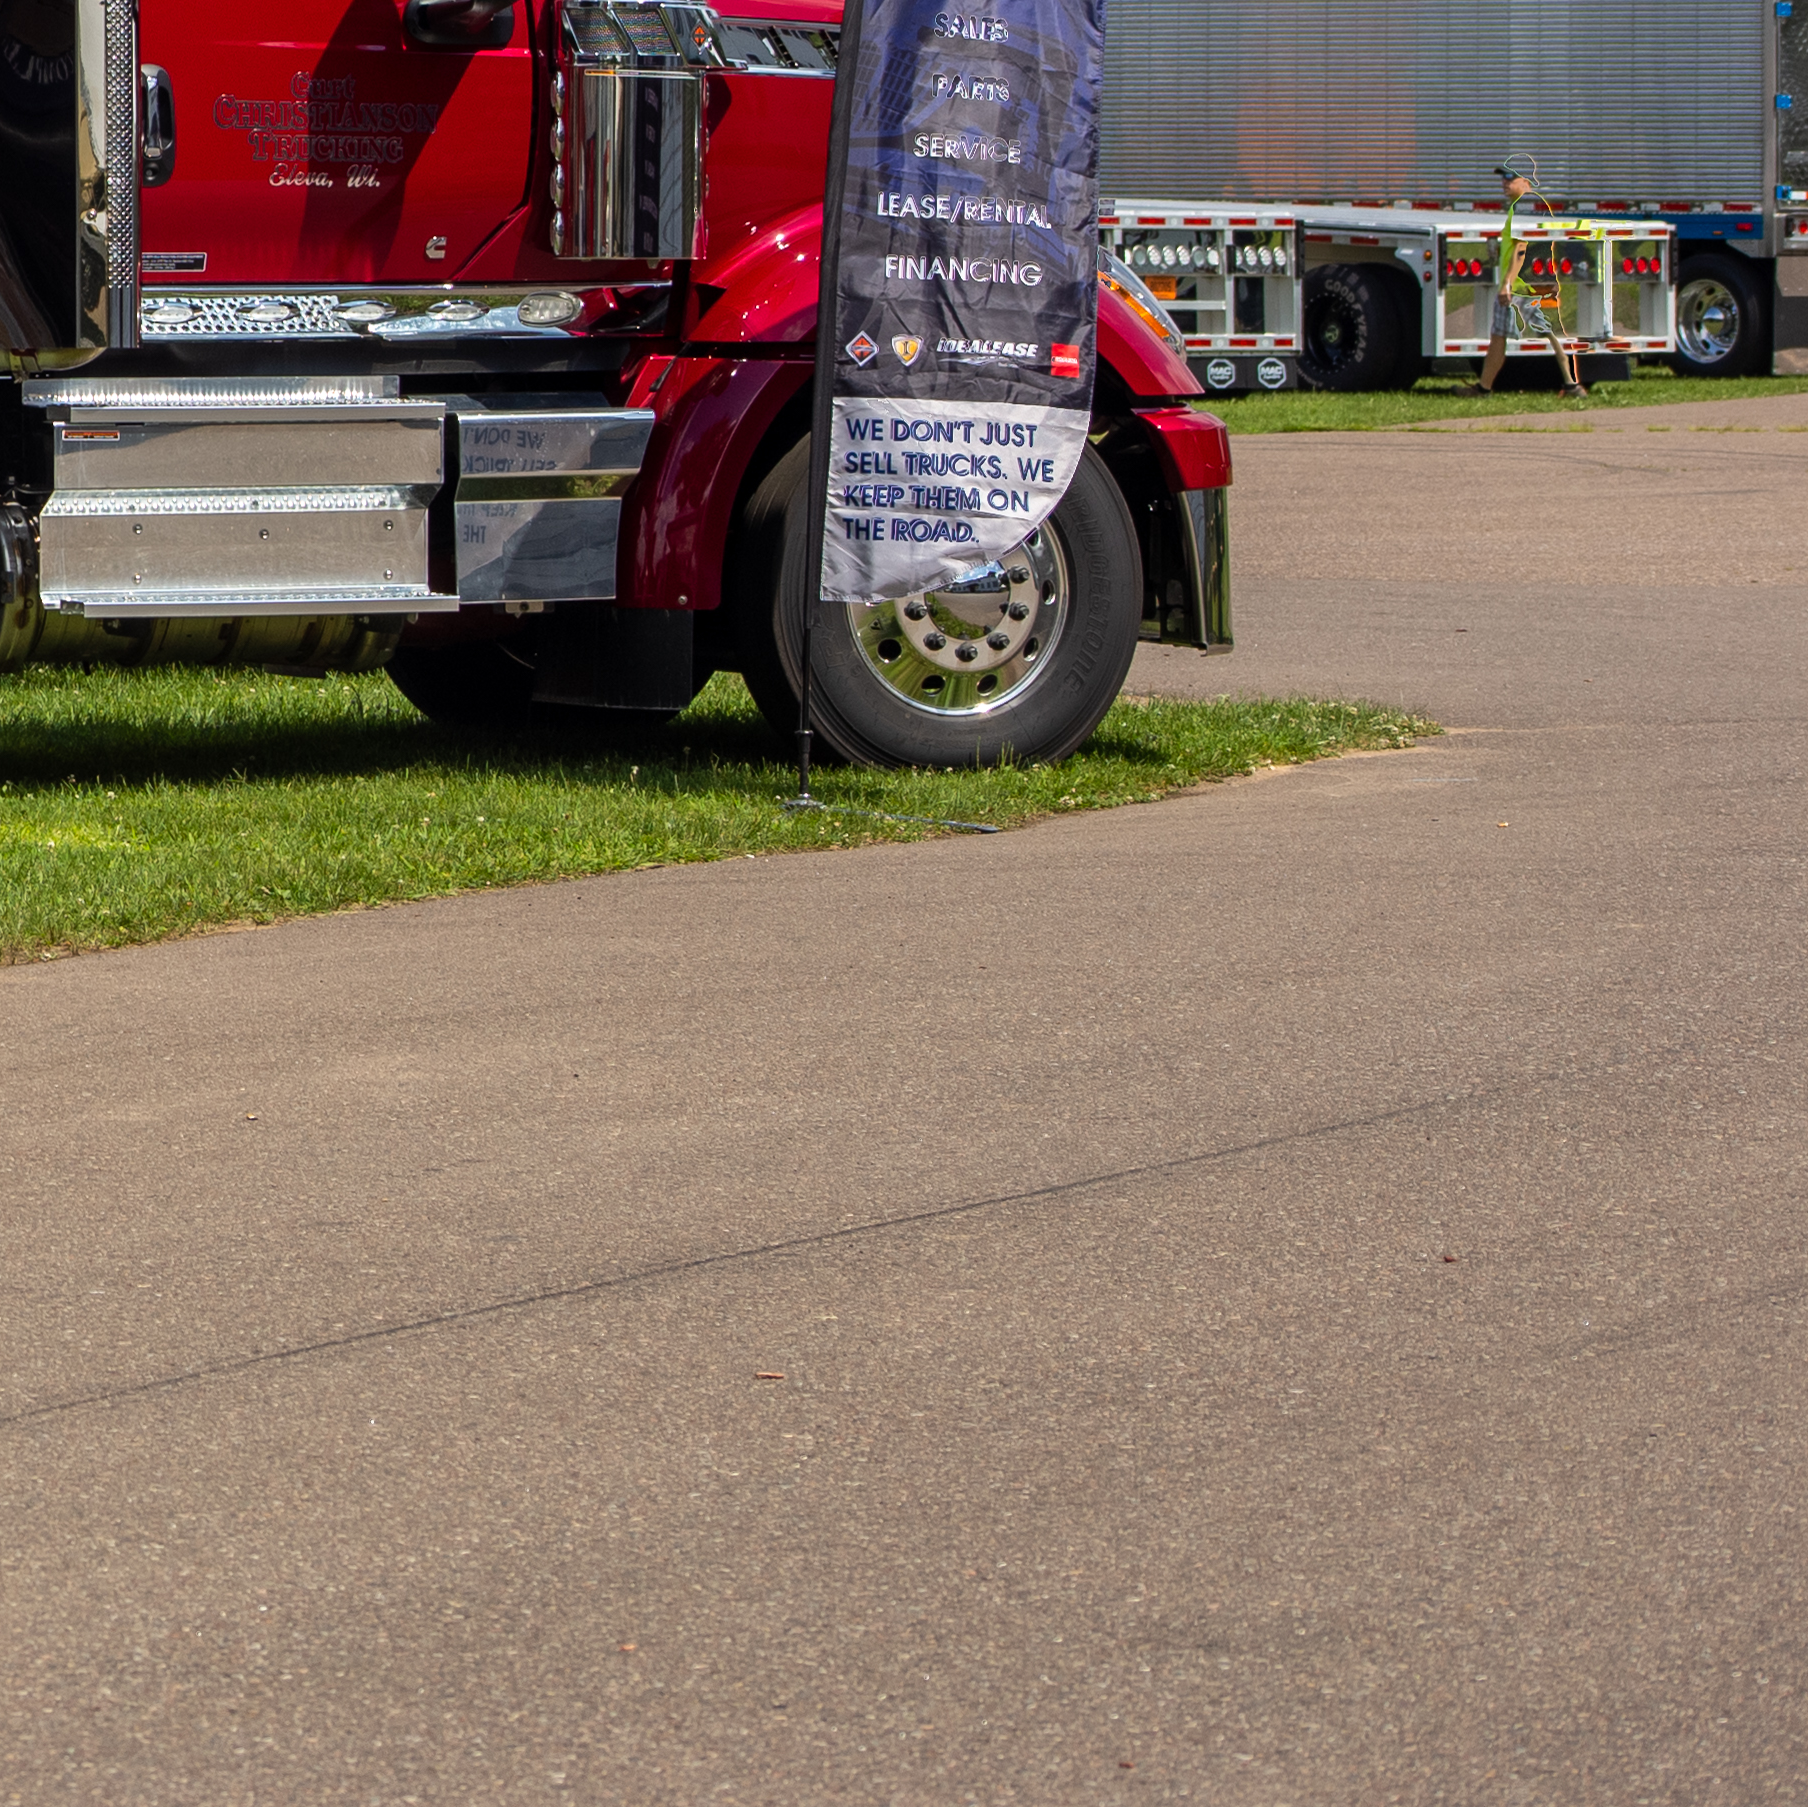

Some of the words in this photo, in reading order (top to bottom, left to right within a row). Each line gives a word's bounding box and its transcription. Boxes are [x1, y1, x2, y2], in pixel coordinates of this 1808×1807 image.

[933, 12, 1009, 44] SALES
[290, 70, 356, 100] Curt
[930, 73, 1010, 103] PARTS
[213, 92, 438, 133] CHRISTIANSON
[249, 127, 404, 163] TRUCKING
[913, 131, 1022, 165] SERVICE
[269, 163, 334, 189] Eleva,
[346, 164, 381, 189] Wi.
[877, 191, 1052, 230] LEASE/RENTAL
[884, 254, 1043, 287] FINANCING
[1325, 278, 1367, 363] GOODYEAR
[936, 337, 1039, 358] IDEALEASE
[1210, 366, 1232, 375] MAC
[1259, 365, 1283, 374] MAC
[846, 417, 884, 442] WE
[891, 418, 974, 446] DON'T
[980, 422, 1038, 449] JUST
[844, 451, 898, 476] SELL
[905, 451, 1008, 482] TRUCKS.
[1017, 457, 1055, 484] WE
[844, 484, 905, 510] KEEP
[908, 484, 982, 512] THEM
[986, 489, 1030, 513] ON
[843, 517, 885, 542] THE
[1064, 482, 1112, 692] RIDGESTONE
